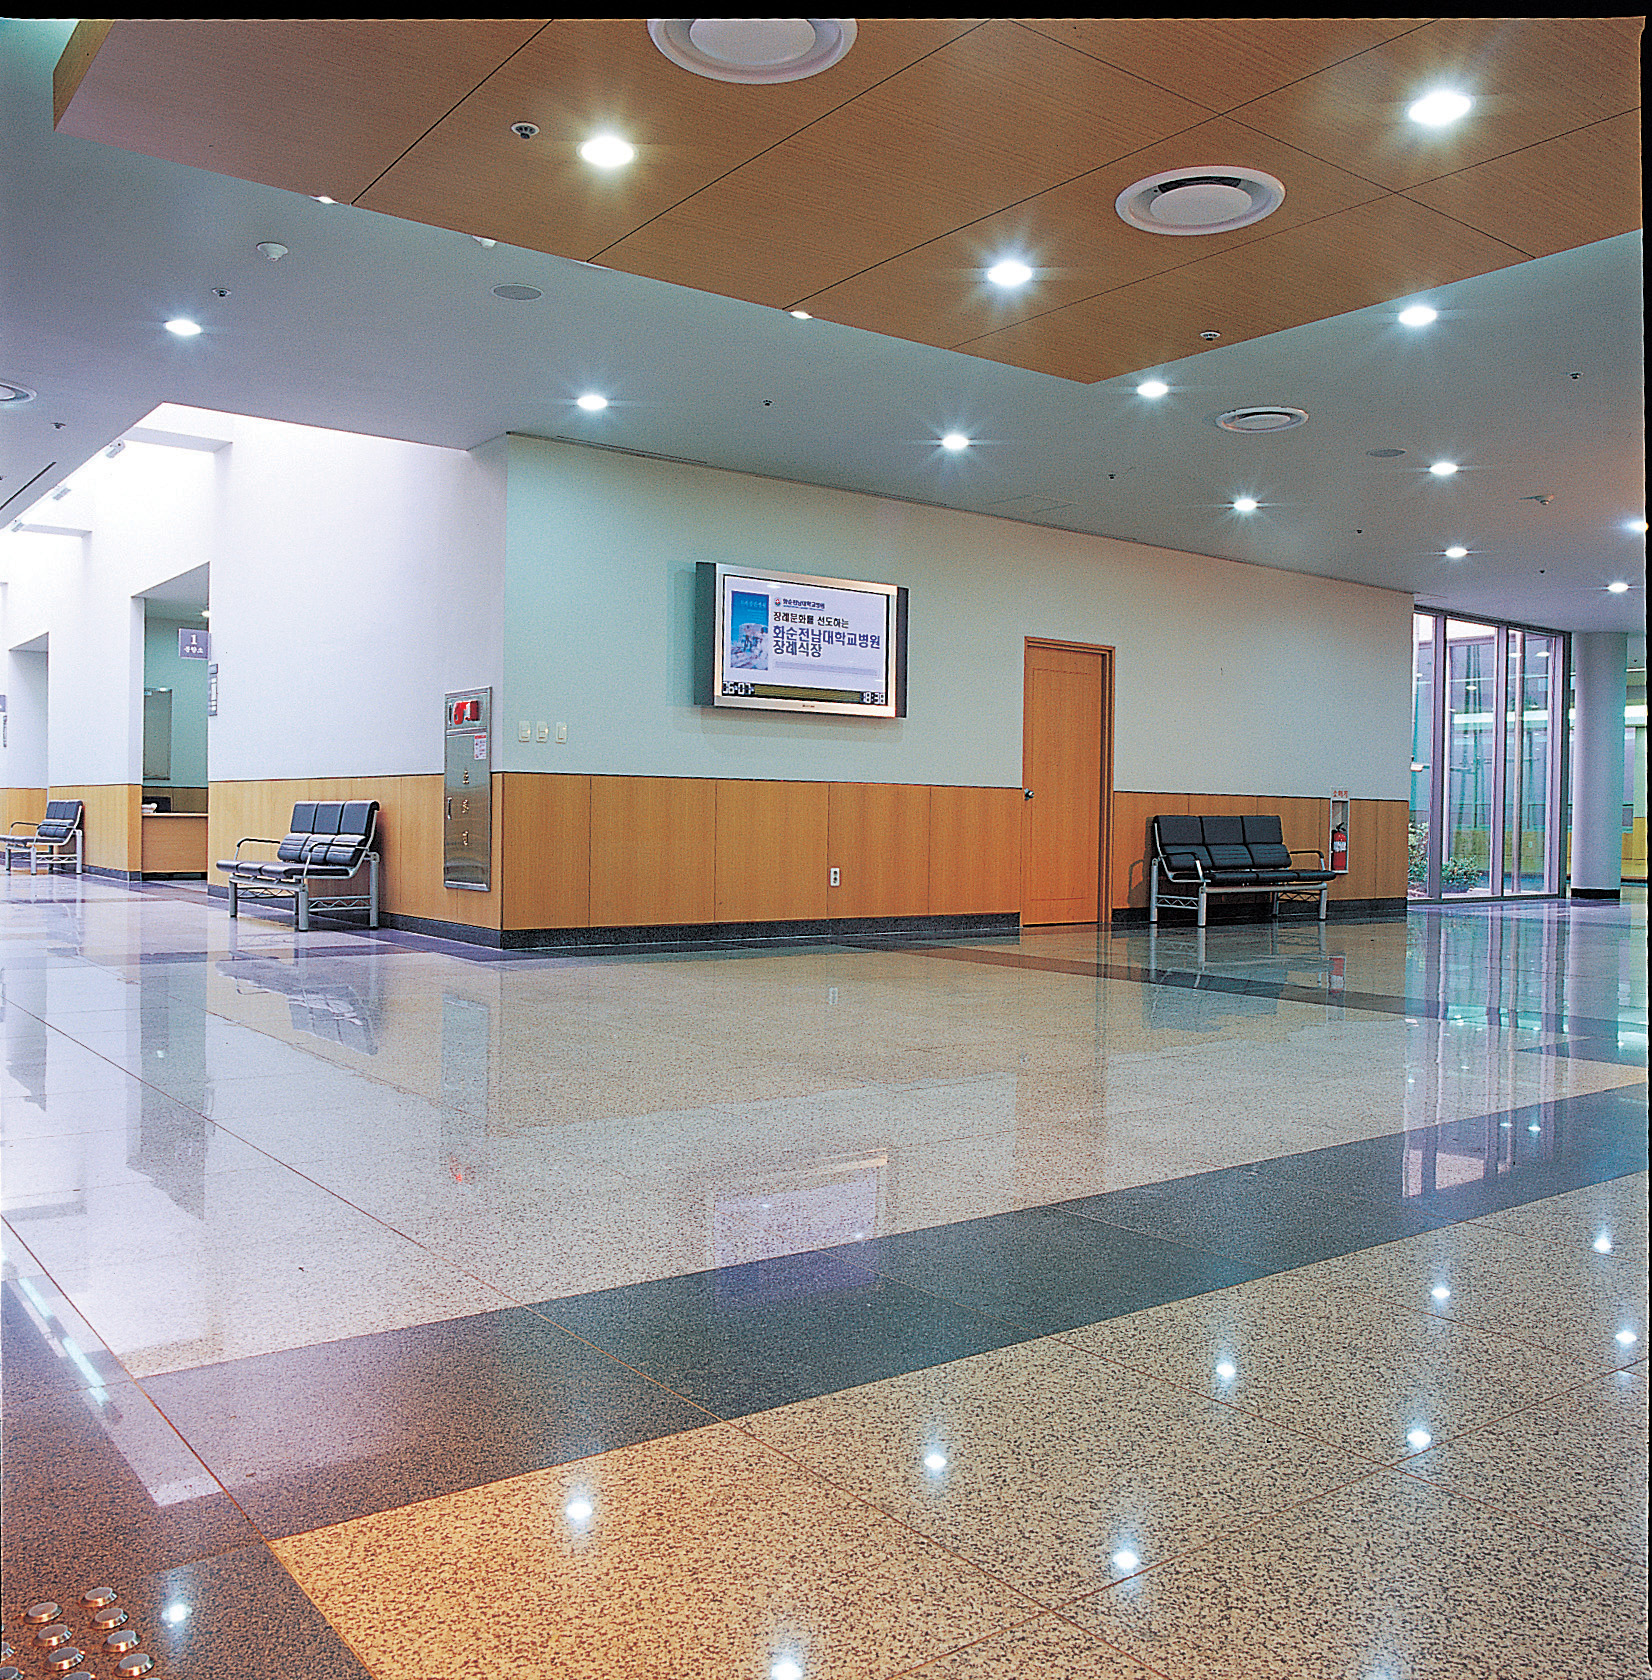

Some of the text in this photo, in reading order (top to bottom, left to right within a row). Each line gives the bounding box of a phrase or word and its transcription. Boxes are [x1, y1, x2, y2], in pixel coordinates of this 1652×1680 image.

[773, 611, 849, 629] 장례문화를 선도하는
[773, 625, 880, 649] 화순전남대학교병원
[773, 640, 822, 658] 장례식장
